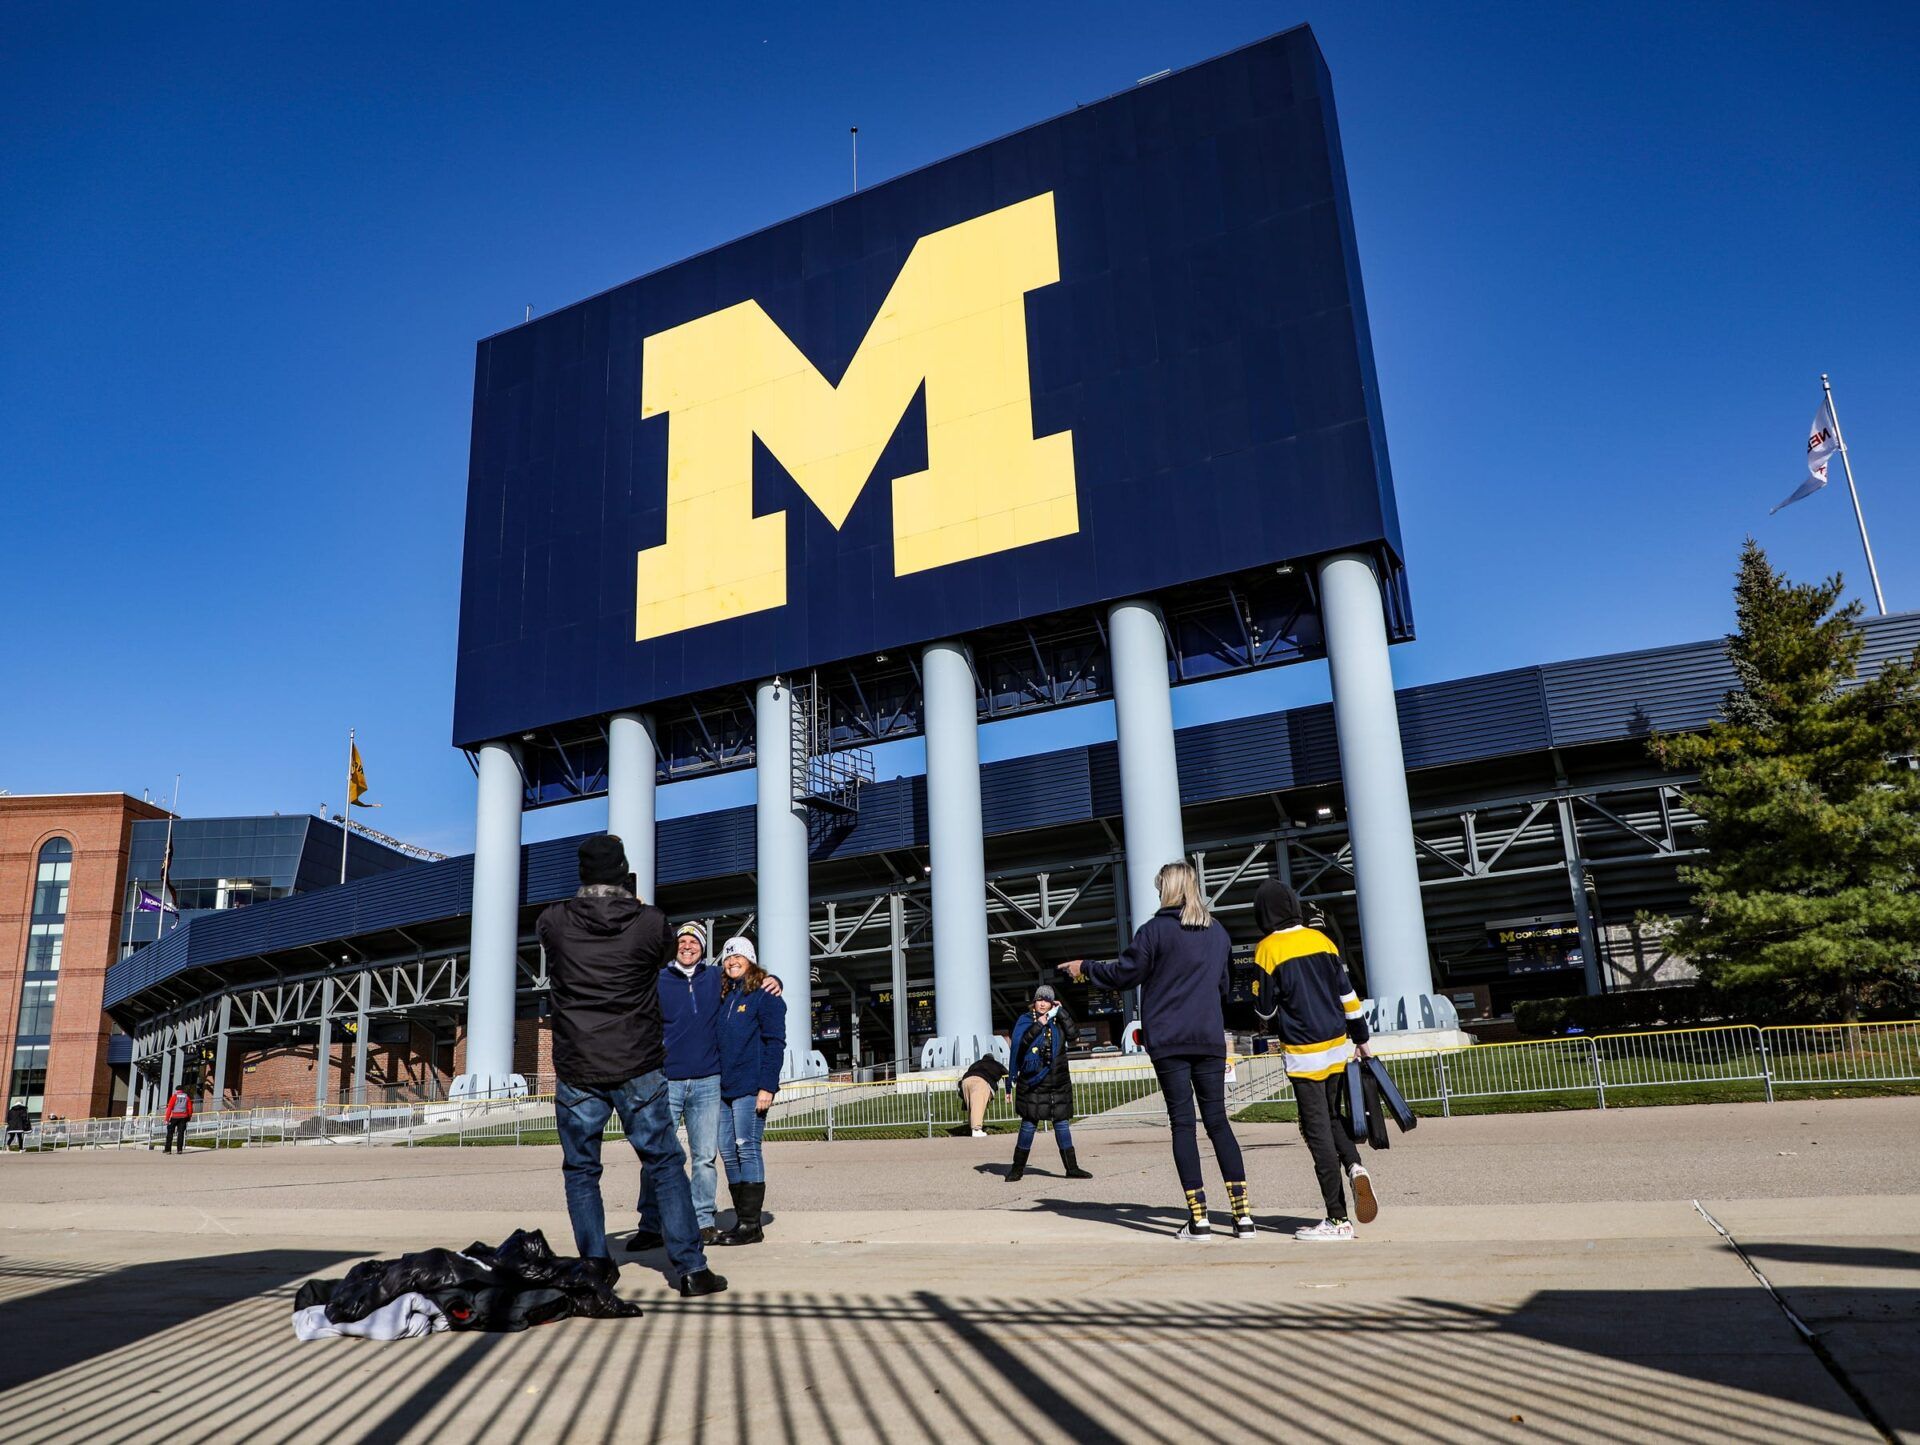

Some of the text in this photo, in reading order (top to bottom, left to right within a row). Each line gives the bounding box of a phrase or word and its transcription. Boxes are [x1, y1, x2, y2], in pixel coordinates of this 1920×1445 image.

[635, 190, 1079, 641] M
[1499, 930, 1516, 944] M
[726, 946, 734, 954] M
[878, 992, 891, 1003] M
[344, 1022, 358, 1033] 14
